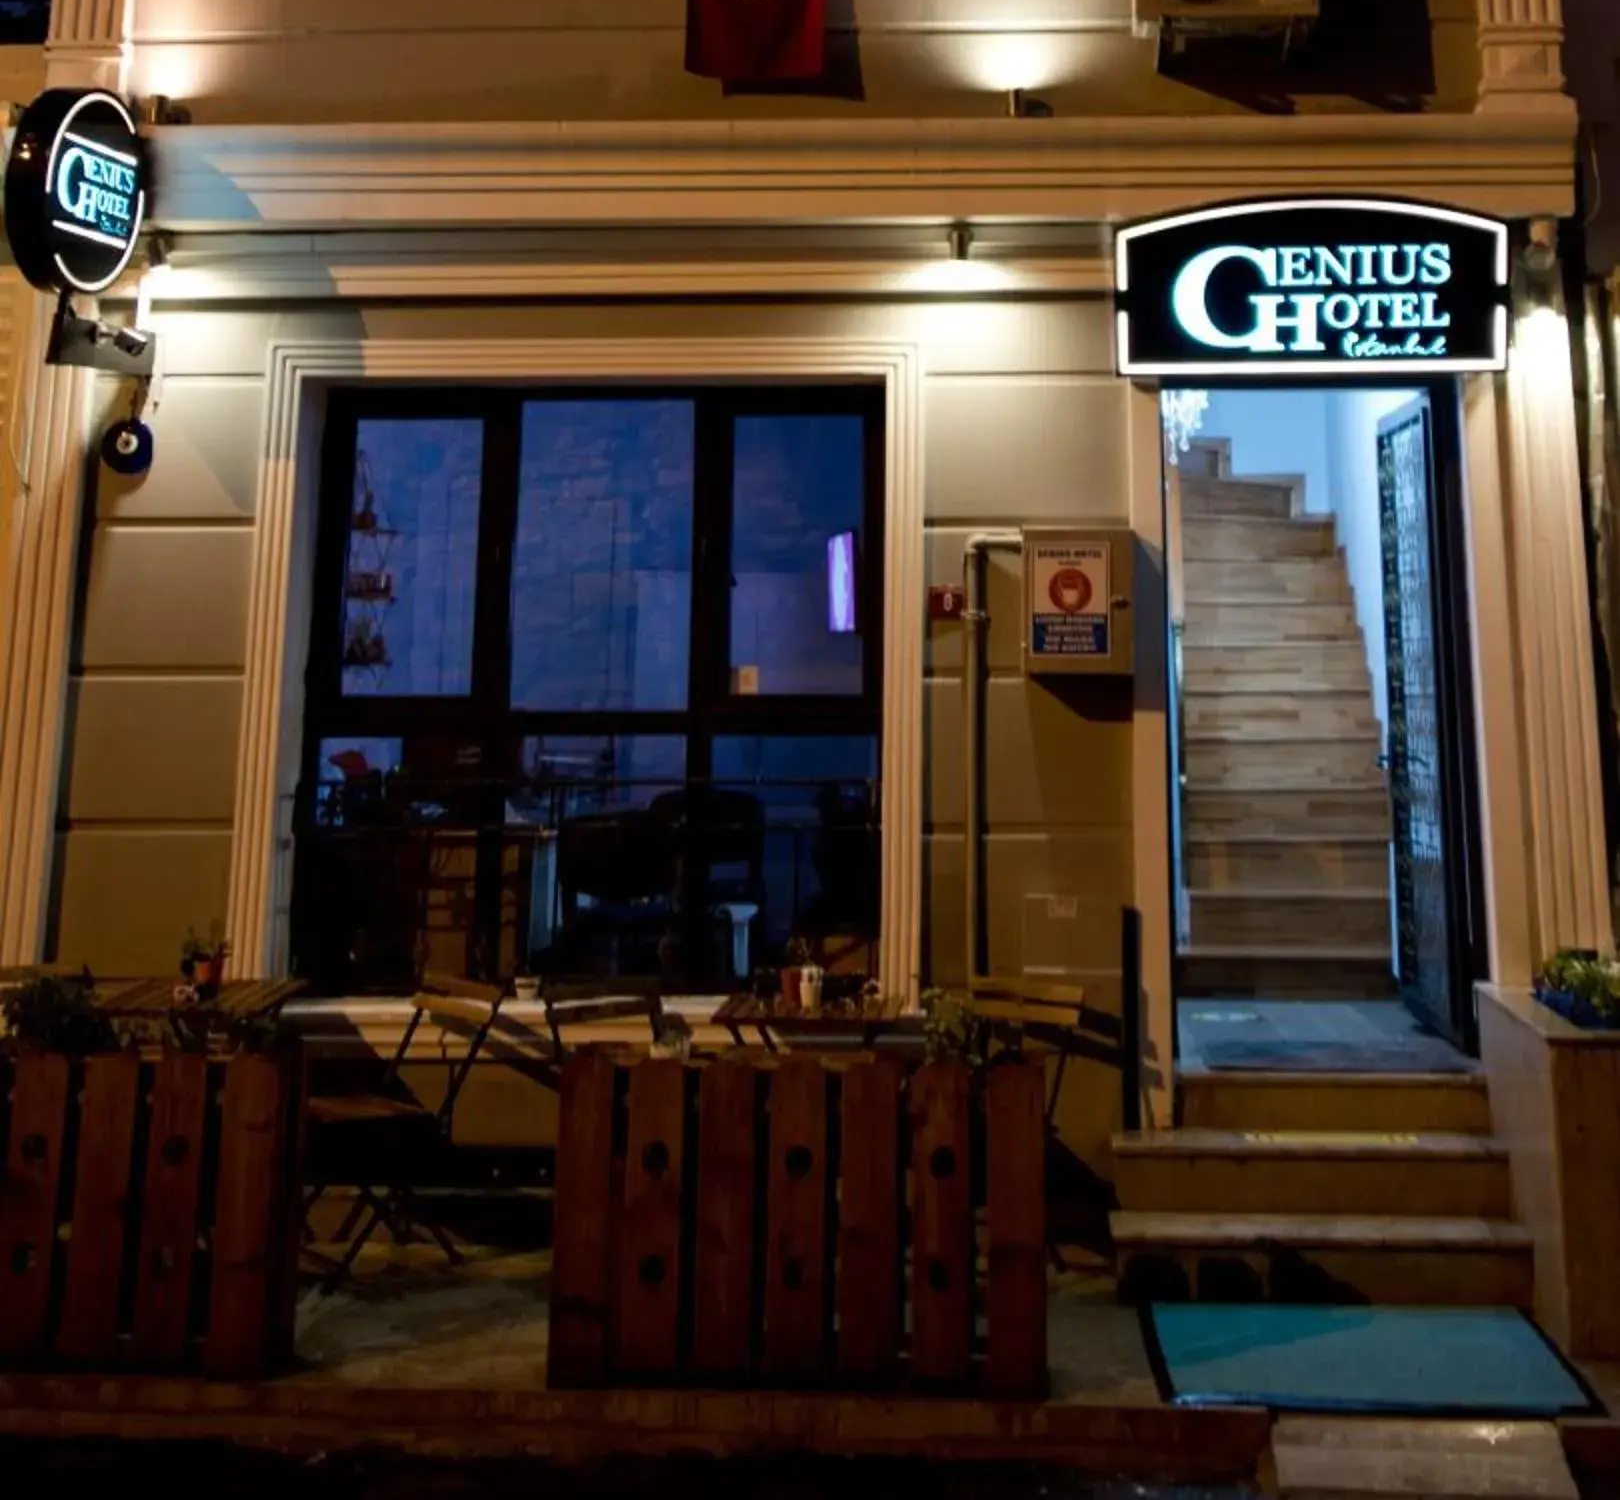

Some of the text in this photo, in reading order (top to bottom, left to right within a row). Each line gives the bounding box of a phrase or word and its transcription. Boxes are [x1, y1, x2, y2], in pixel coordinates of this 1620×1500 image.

[58, 147, 135, 214] GENIUS
[74, 182, 130, 223] HOTEL
[1173, 243, 1452, 348] GENIUS
[1249, 294, 1451, 352] HOTEL
